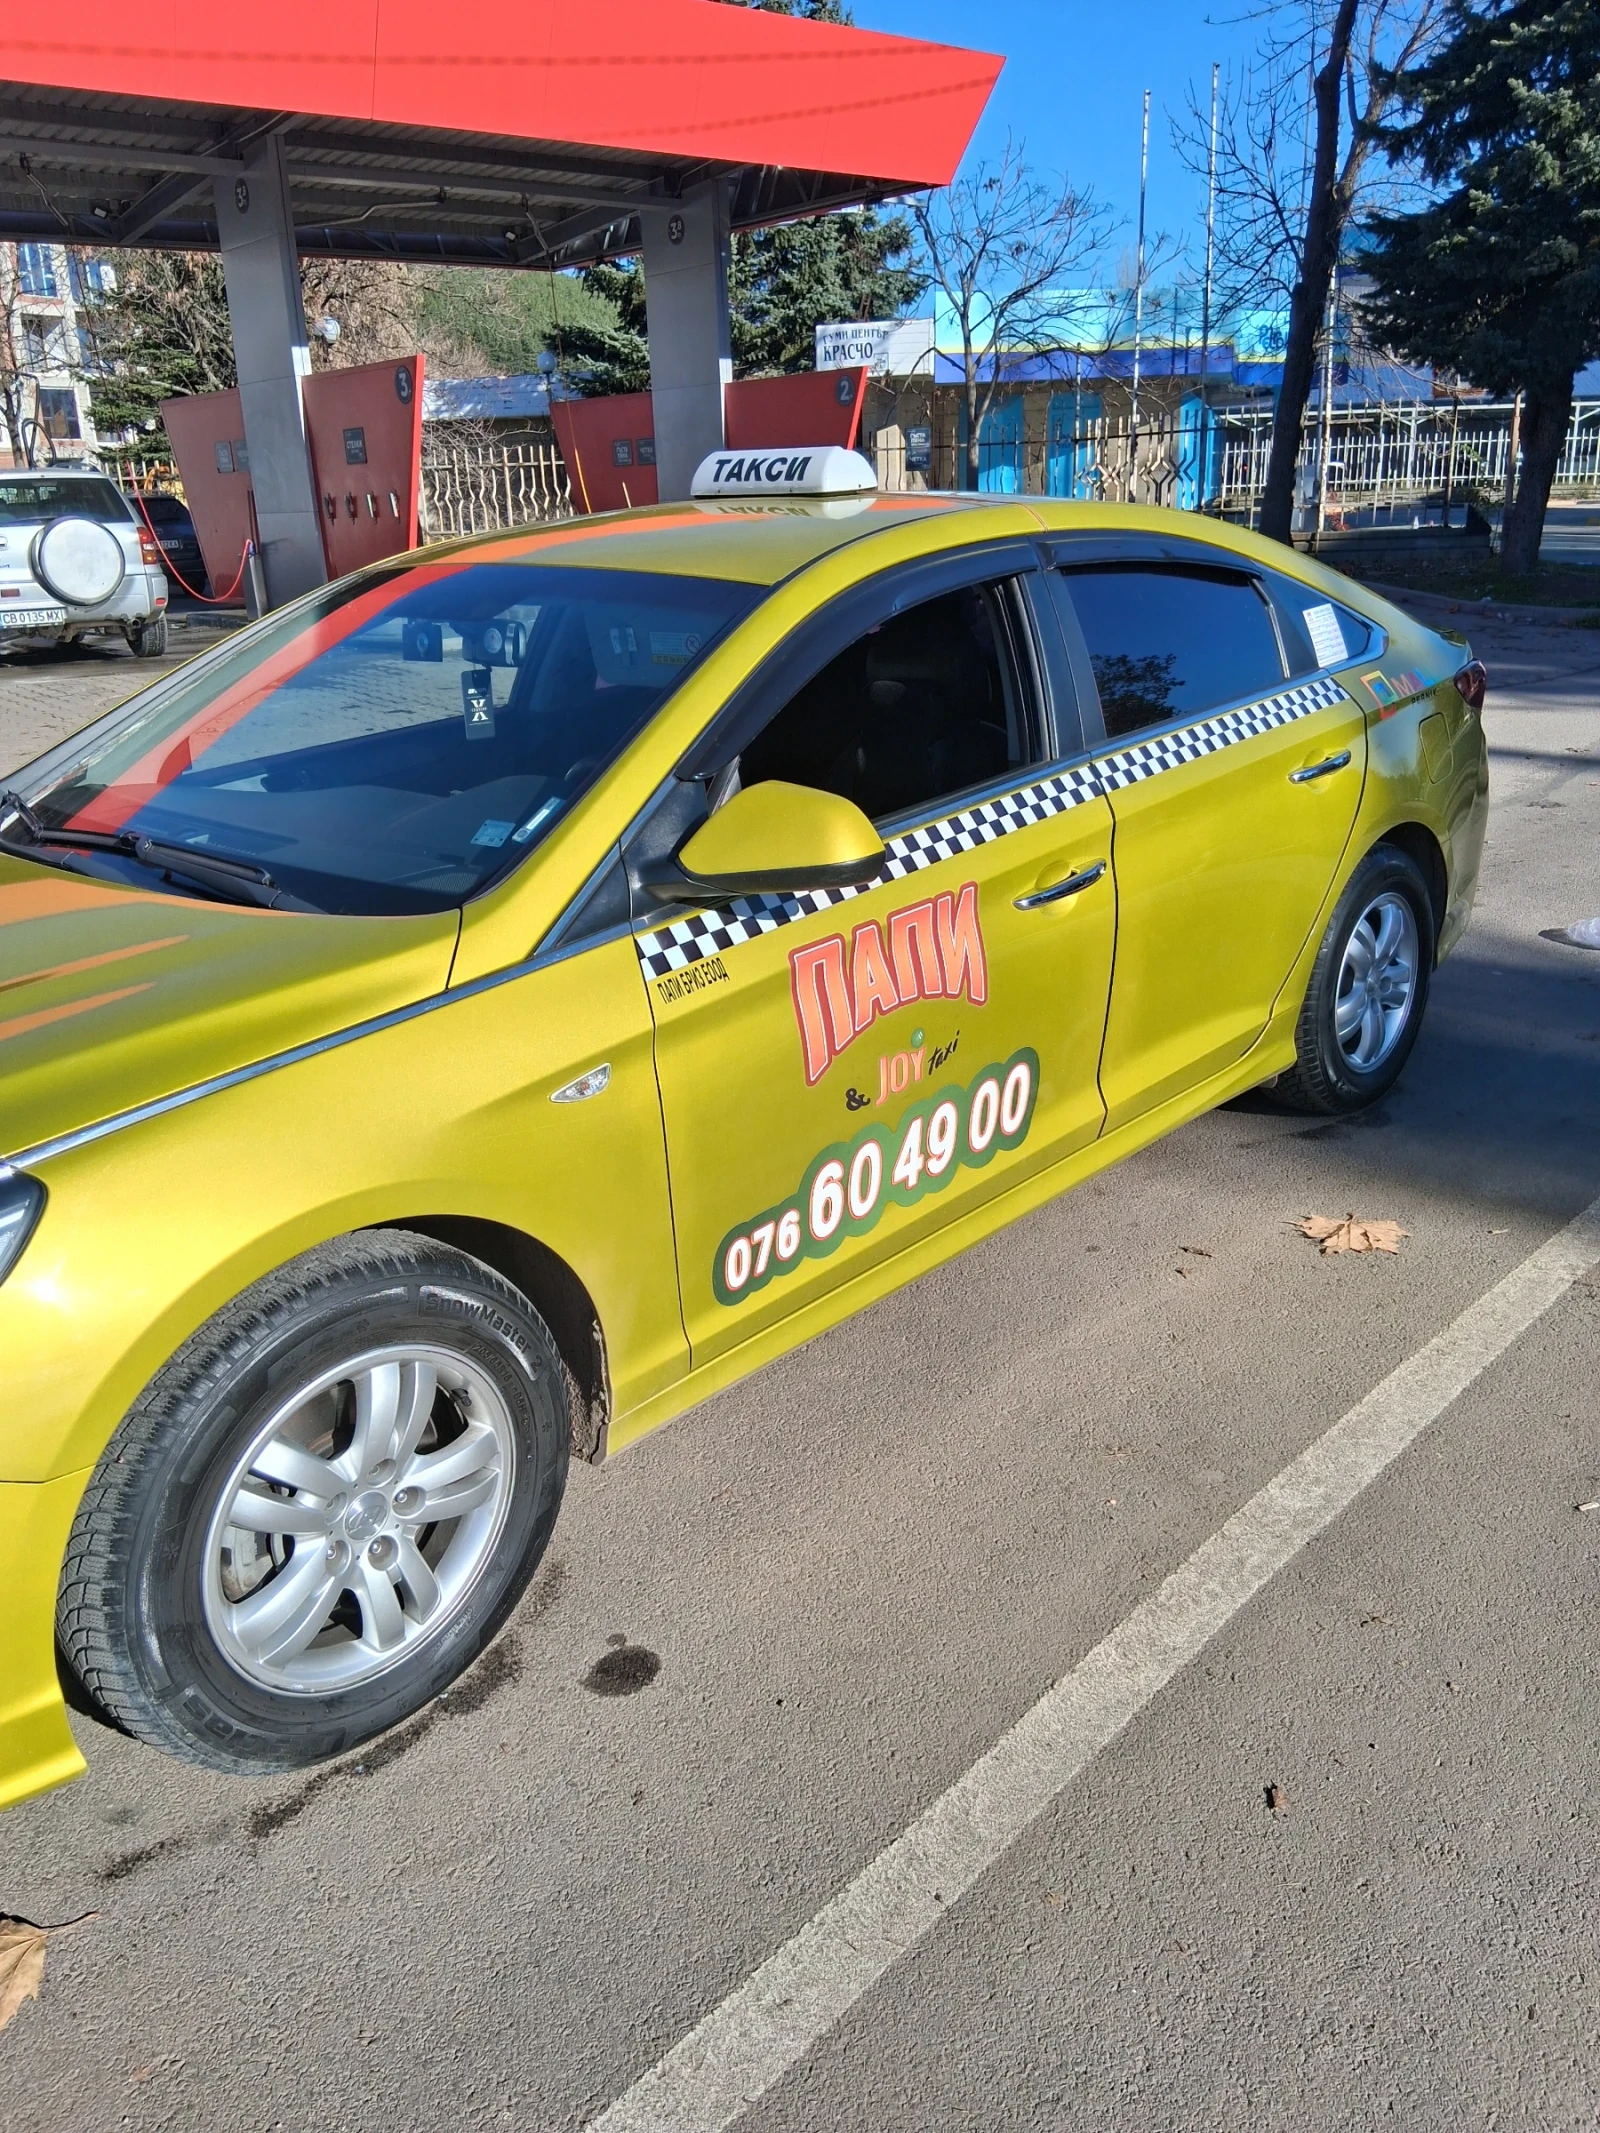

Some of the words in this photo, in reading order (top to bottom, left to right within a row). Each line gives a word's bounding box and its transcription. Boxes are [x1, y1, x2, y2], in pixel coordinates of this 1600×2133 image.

[823, 330, 848, 345] ГУМИ
[851, 328, 888, 340] ЦЕНТЪР
[824, 342, 873, 361] КРАСЧО
[713, 456, 812, 482] ТАКСИ
[3, 613, 17, 624] CB
[46, 610, 60, 621] MX
[657, 976, 685, 1004] ПАПИ
[679, 966, 706, 994] БРИЗ
[700, 957, 730, 985] ЕООД
[789, 882, 987, 1086] ПАПИ
[845, 1088, 871, 1111] &
[875, 1046, 926, 1106] JOY
[928, 1030, 960, 1076] taxi
[725, 1208, 800, 1291] 076
[809, 1139, 882, 1241] 60
[891, 1100, 958, 1190] 49
[968, 1062, 1031, 1153] 00
[425, 1293, 532, 1354] SnowMaster
[531, 1354, 543, 1374] 2
